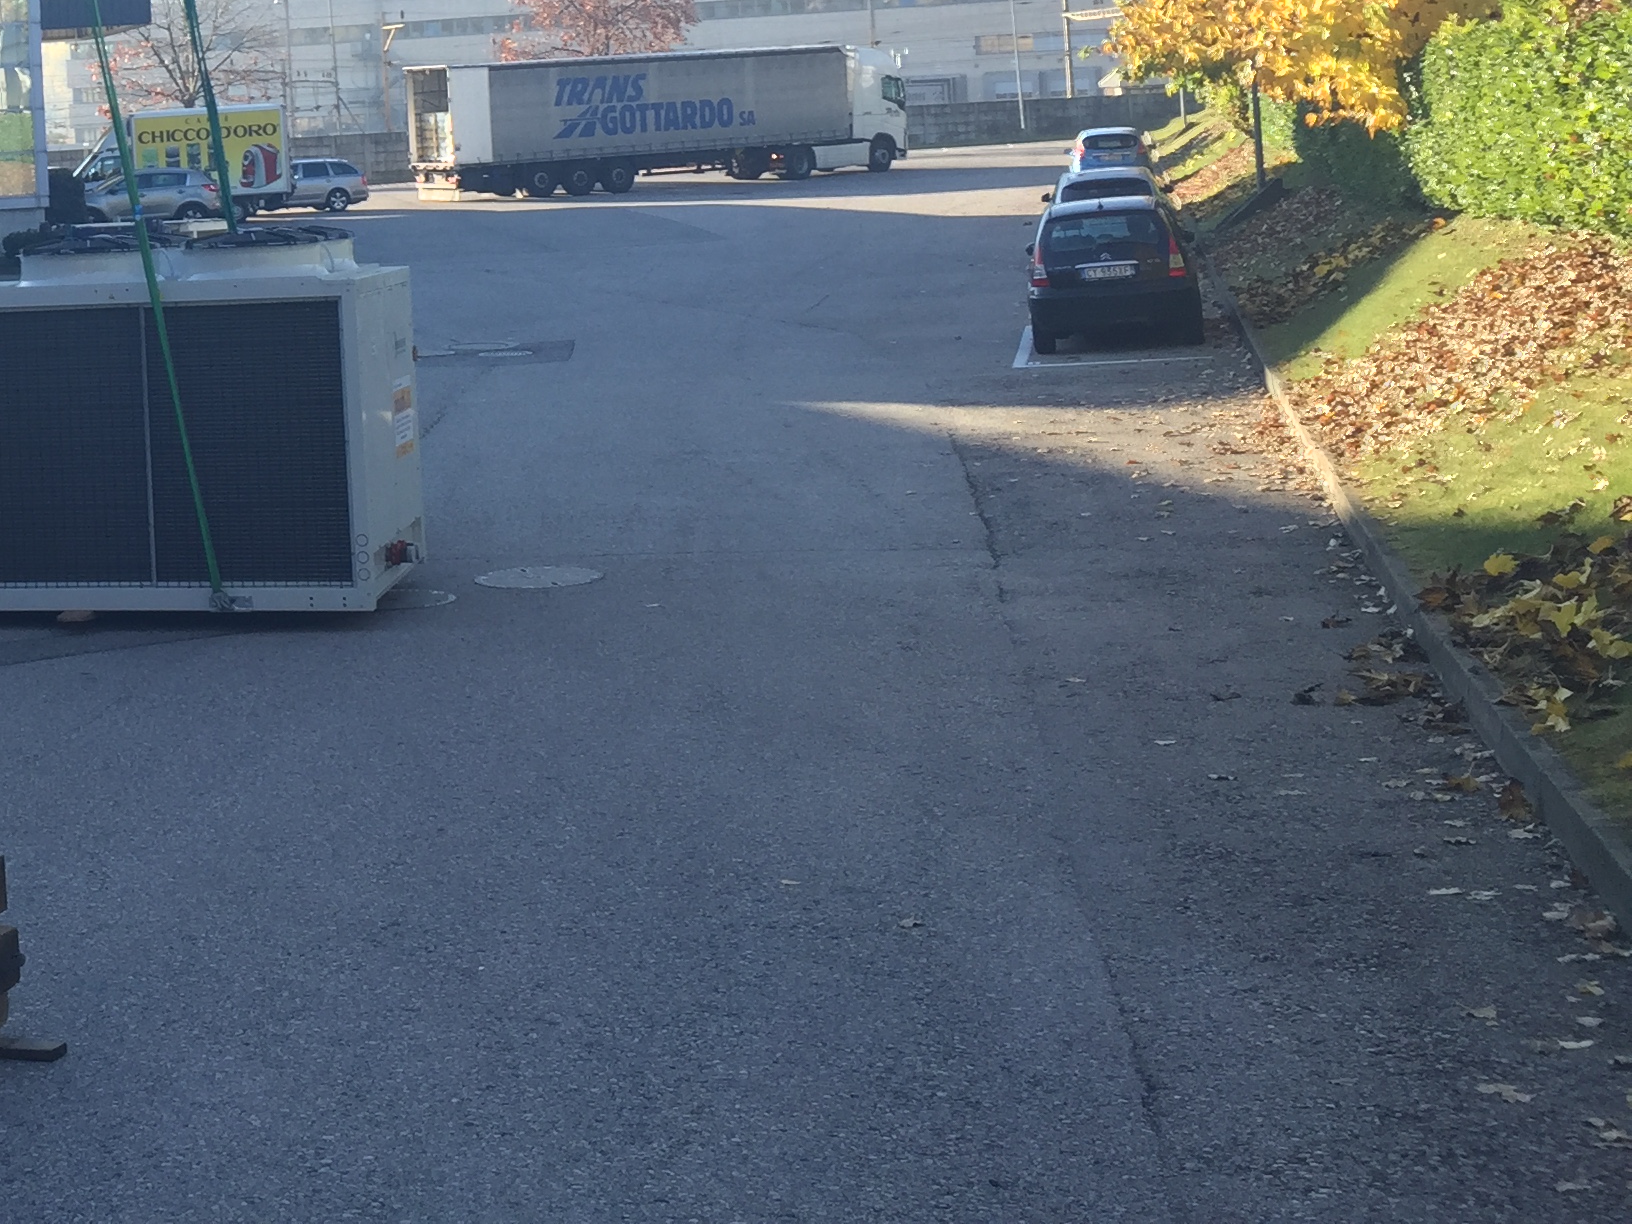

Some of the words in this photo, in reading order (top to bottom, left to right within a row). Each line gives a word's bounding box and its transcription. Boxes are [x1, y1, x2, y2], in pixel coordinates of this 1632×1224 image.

[554, 73, 647, 106] TRANS
[599, 97, 734, 137] GOTTARDO
[739, 110, 757, 126] SA
[138, 127, 210, 144] CHICCO
